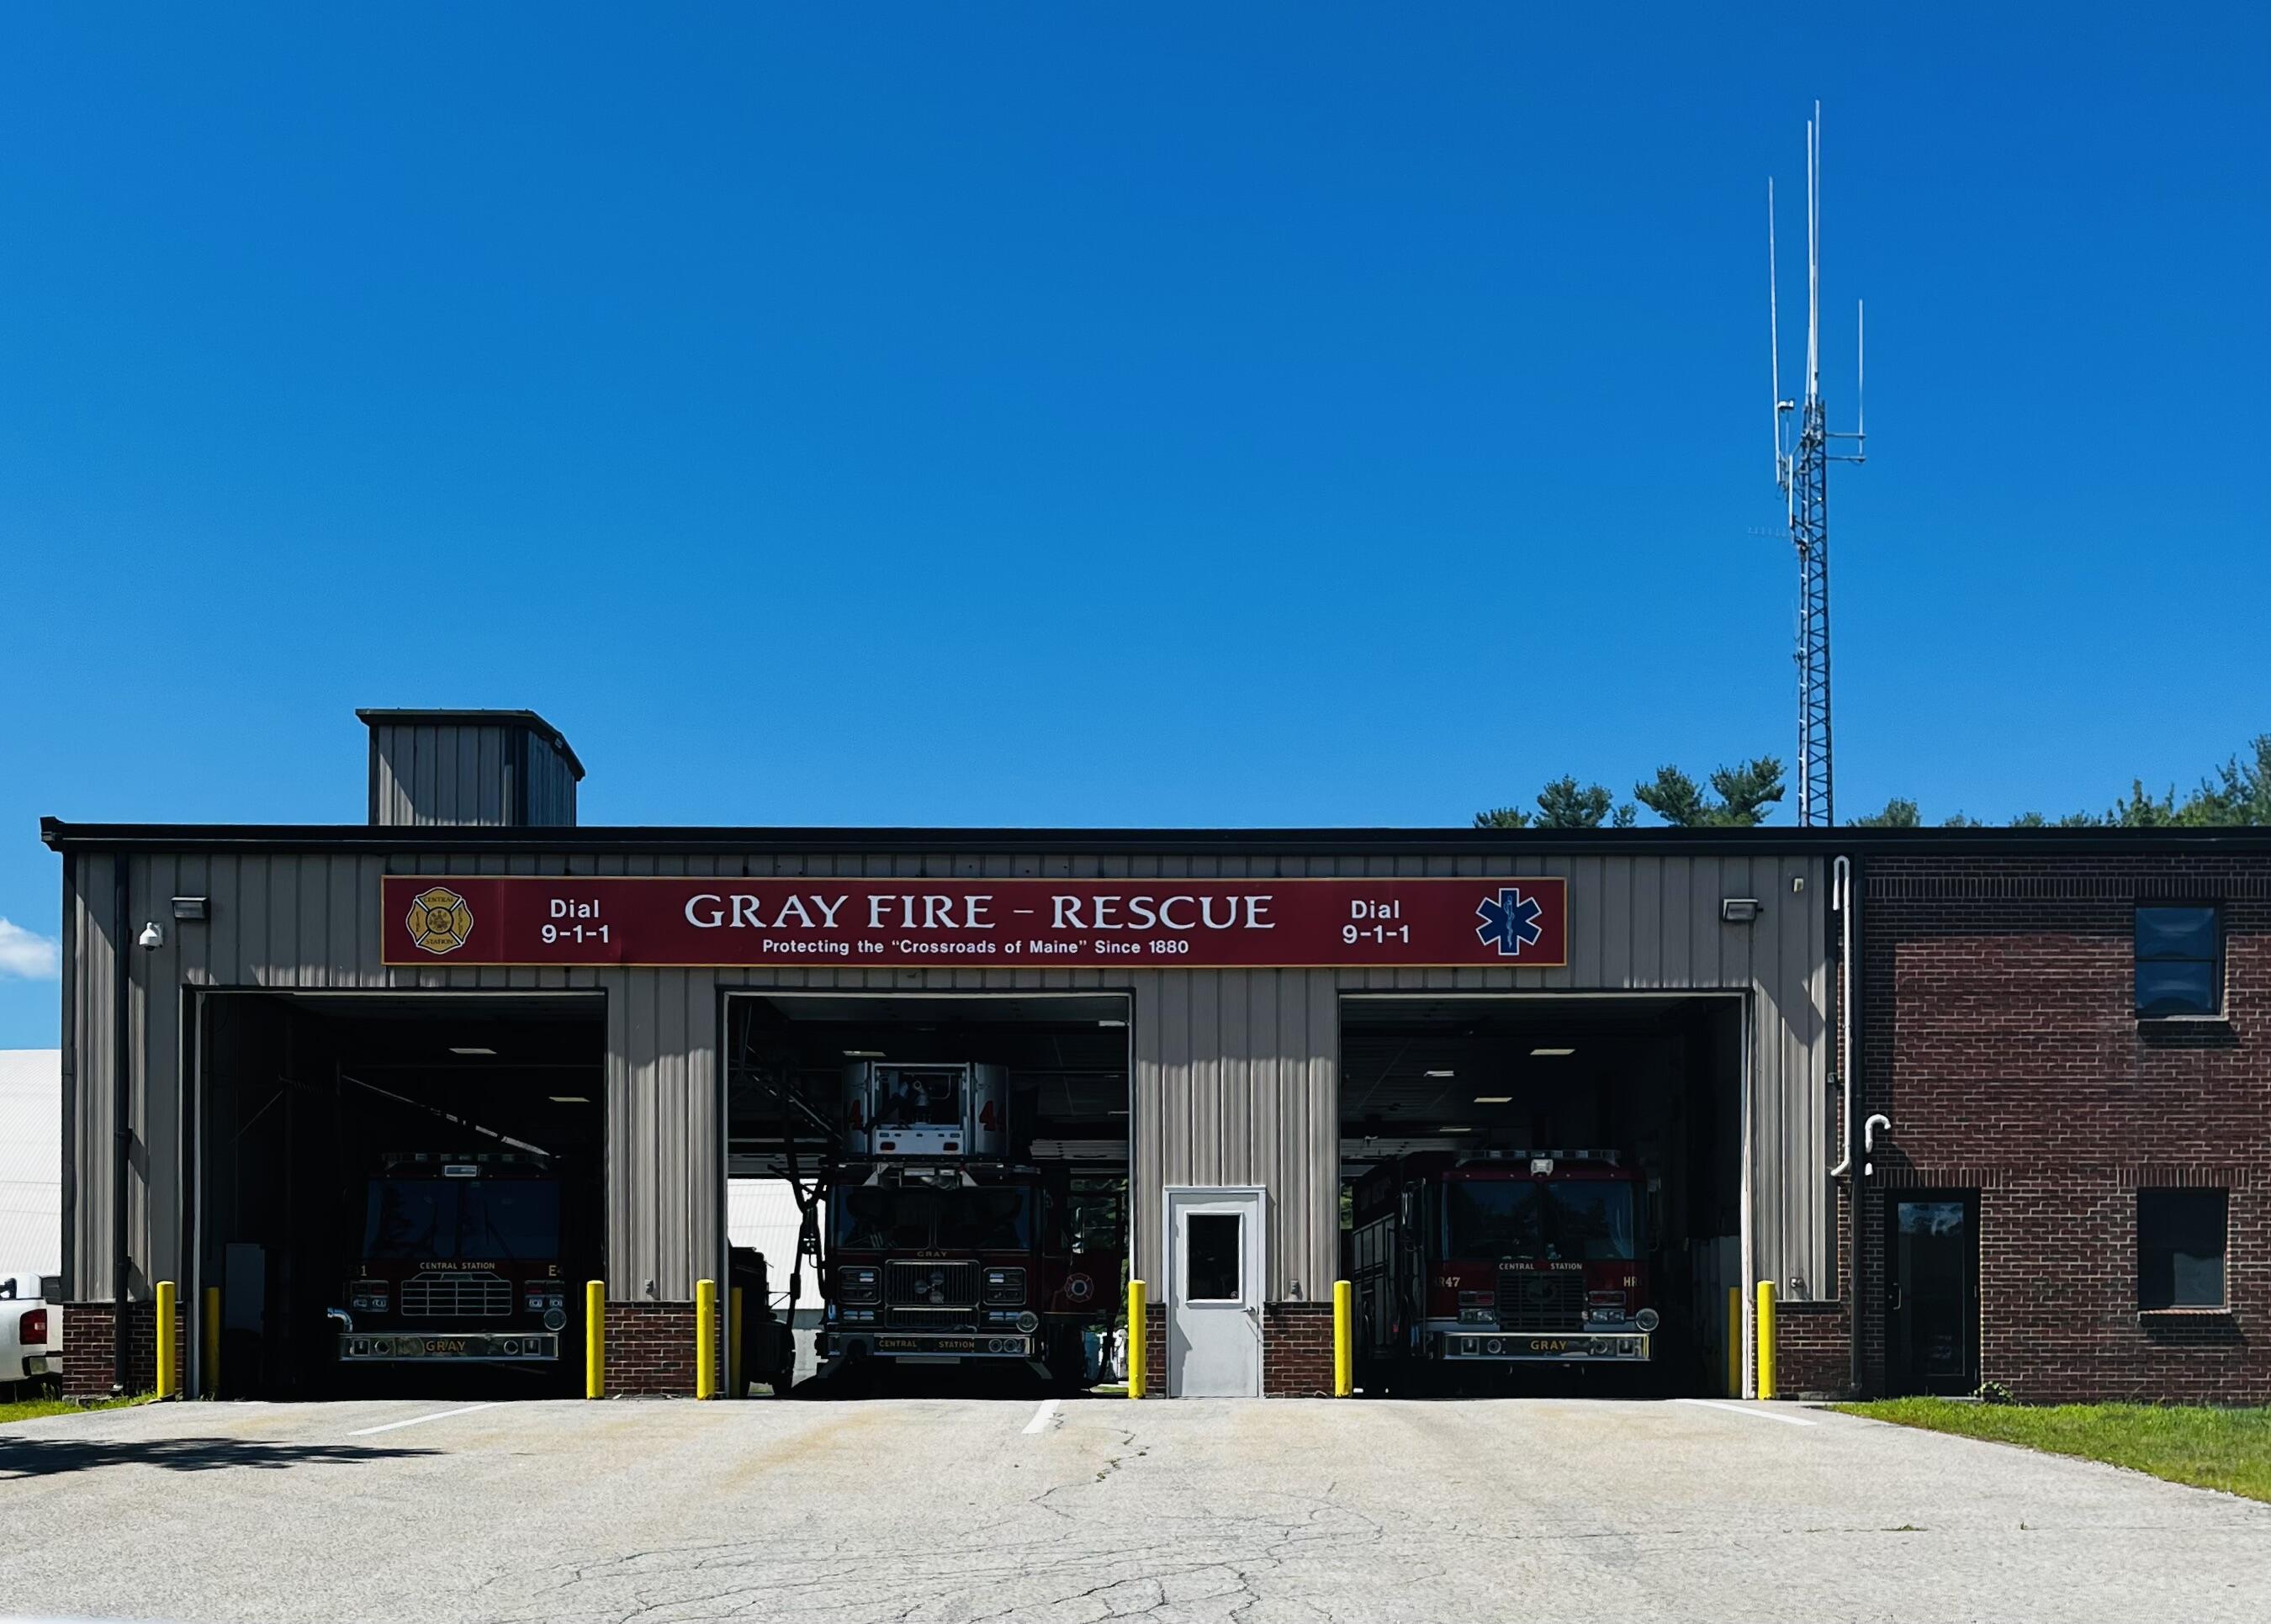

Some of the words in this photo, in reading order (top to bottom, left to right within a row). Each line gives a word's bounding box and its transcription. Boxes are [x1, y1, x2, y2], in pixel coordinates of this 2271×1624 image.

[551, 900, 598, 918] Dial
[686, 895, 848, 928] GRAY
[868, 896, 995, 928] FIRE
[1051, 896, 1275, 929] RESCUE
[1352, 900, 1399, 918] Dial
[542, 924, 608, 943] 9-1-1
[1343, 925, 1408, 944] 9-1-1
[764, 939, 849, 955] Protecting
[858, 940, 883, 953] the
[1005, 940, 1021, 953] of
[1095, 940, 1141, 953] Since
[1149, 940, 1188, 953] 1880
[425, 1341, 466, 1352] GRAY
[879, 1340, 918, 1348] CENTRAL
[938, 1340, 975, 1348] STATION
[1530, 1340, 1568, 1351] GRAY
